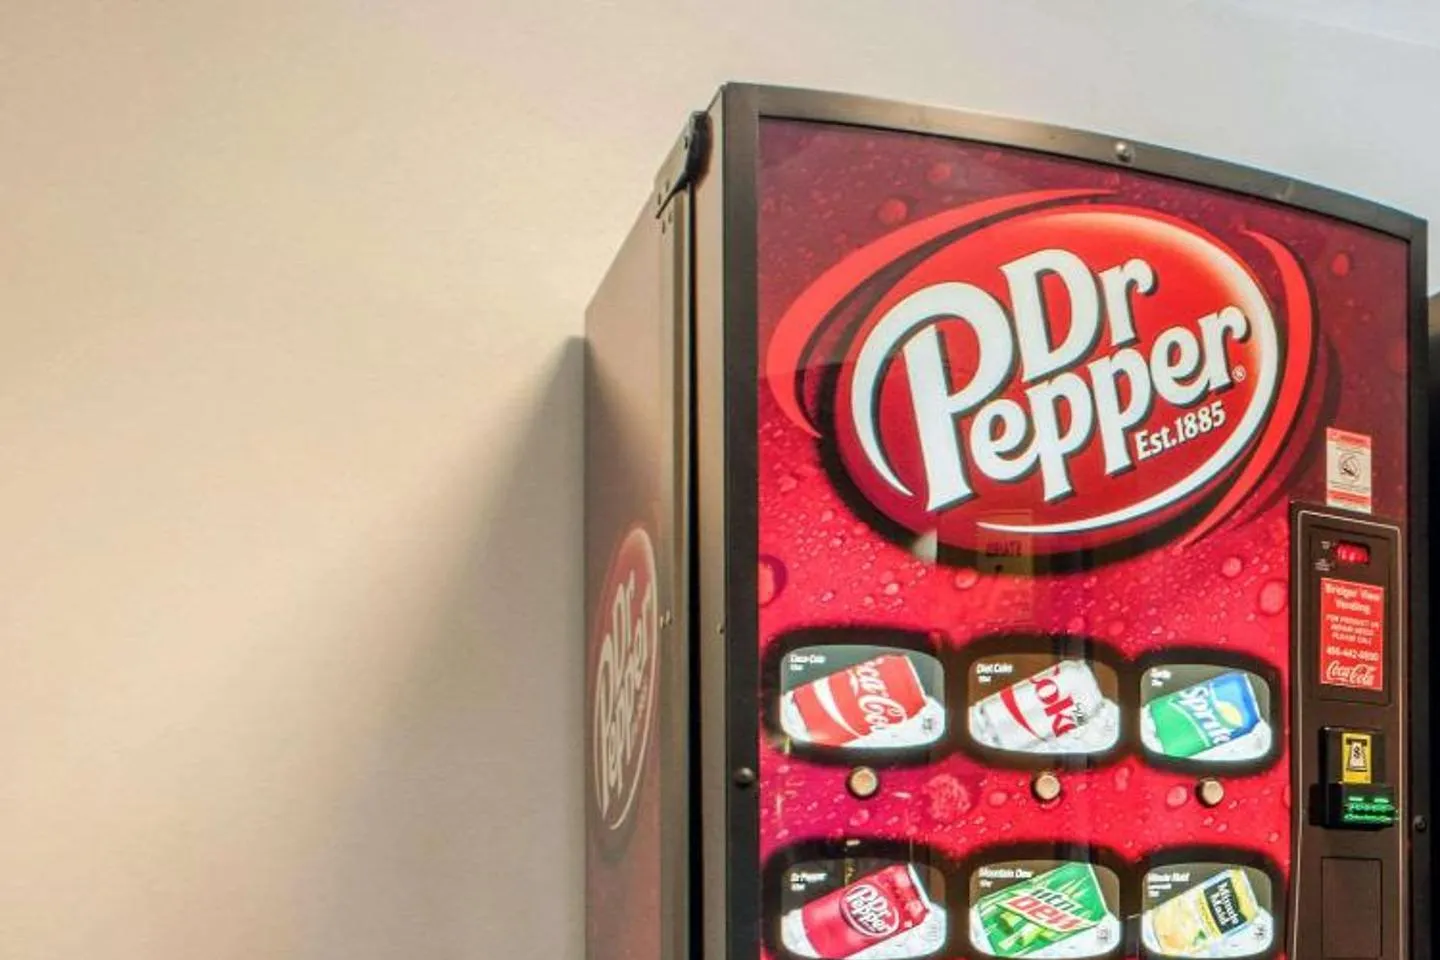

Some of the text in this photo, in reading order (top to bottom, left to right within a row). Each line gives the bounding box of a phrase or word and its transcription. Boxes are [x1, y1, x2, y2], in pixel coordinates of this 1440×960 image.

[999, 247, 1158, 383] Dr
[852, 281, 1250, 512] Pepper
[595, 580, 651, 822] Pepper
[613, 568, 636, 698] Dr
[1326, 660, 1377, 687] Coca-Cola
